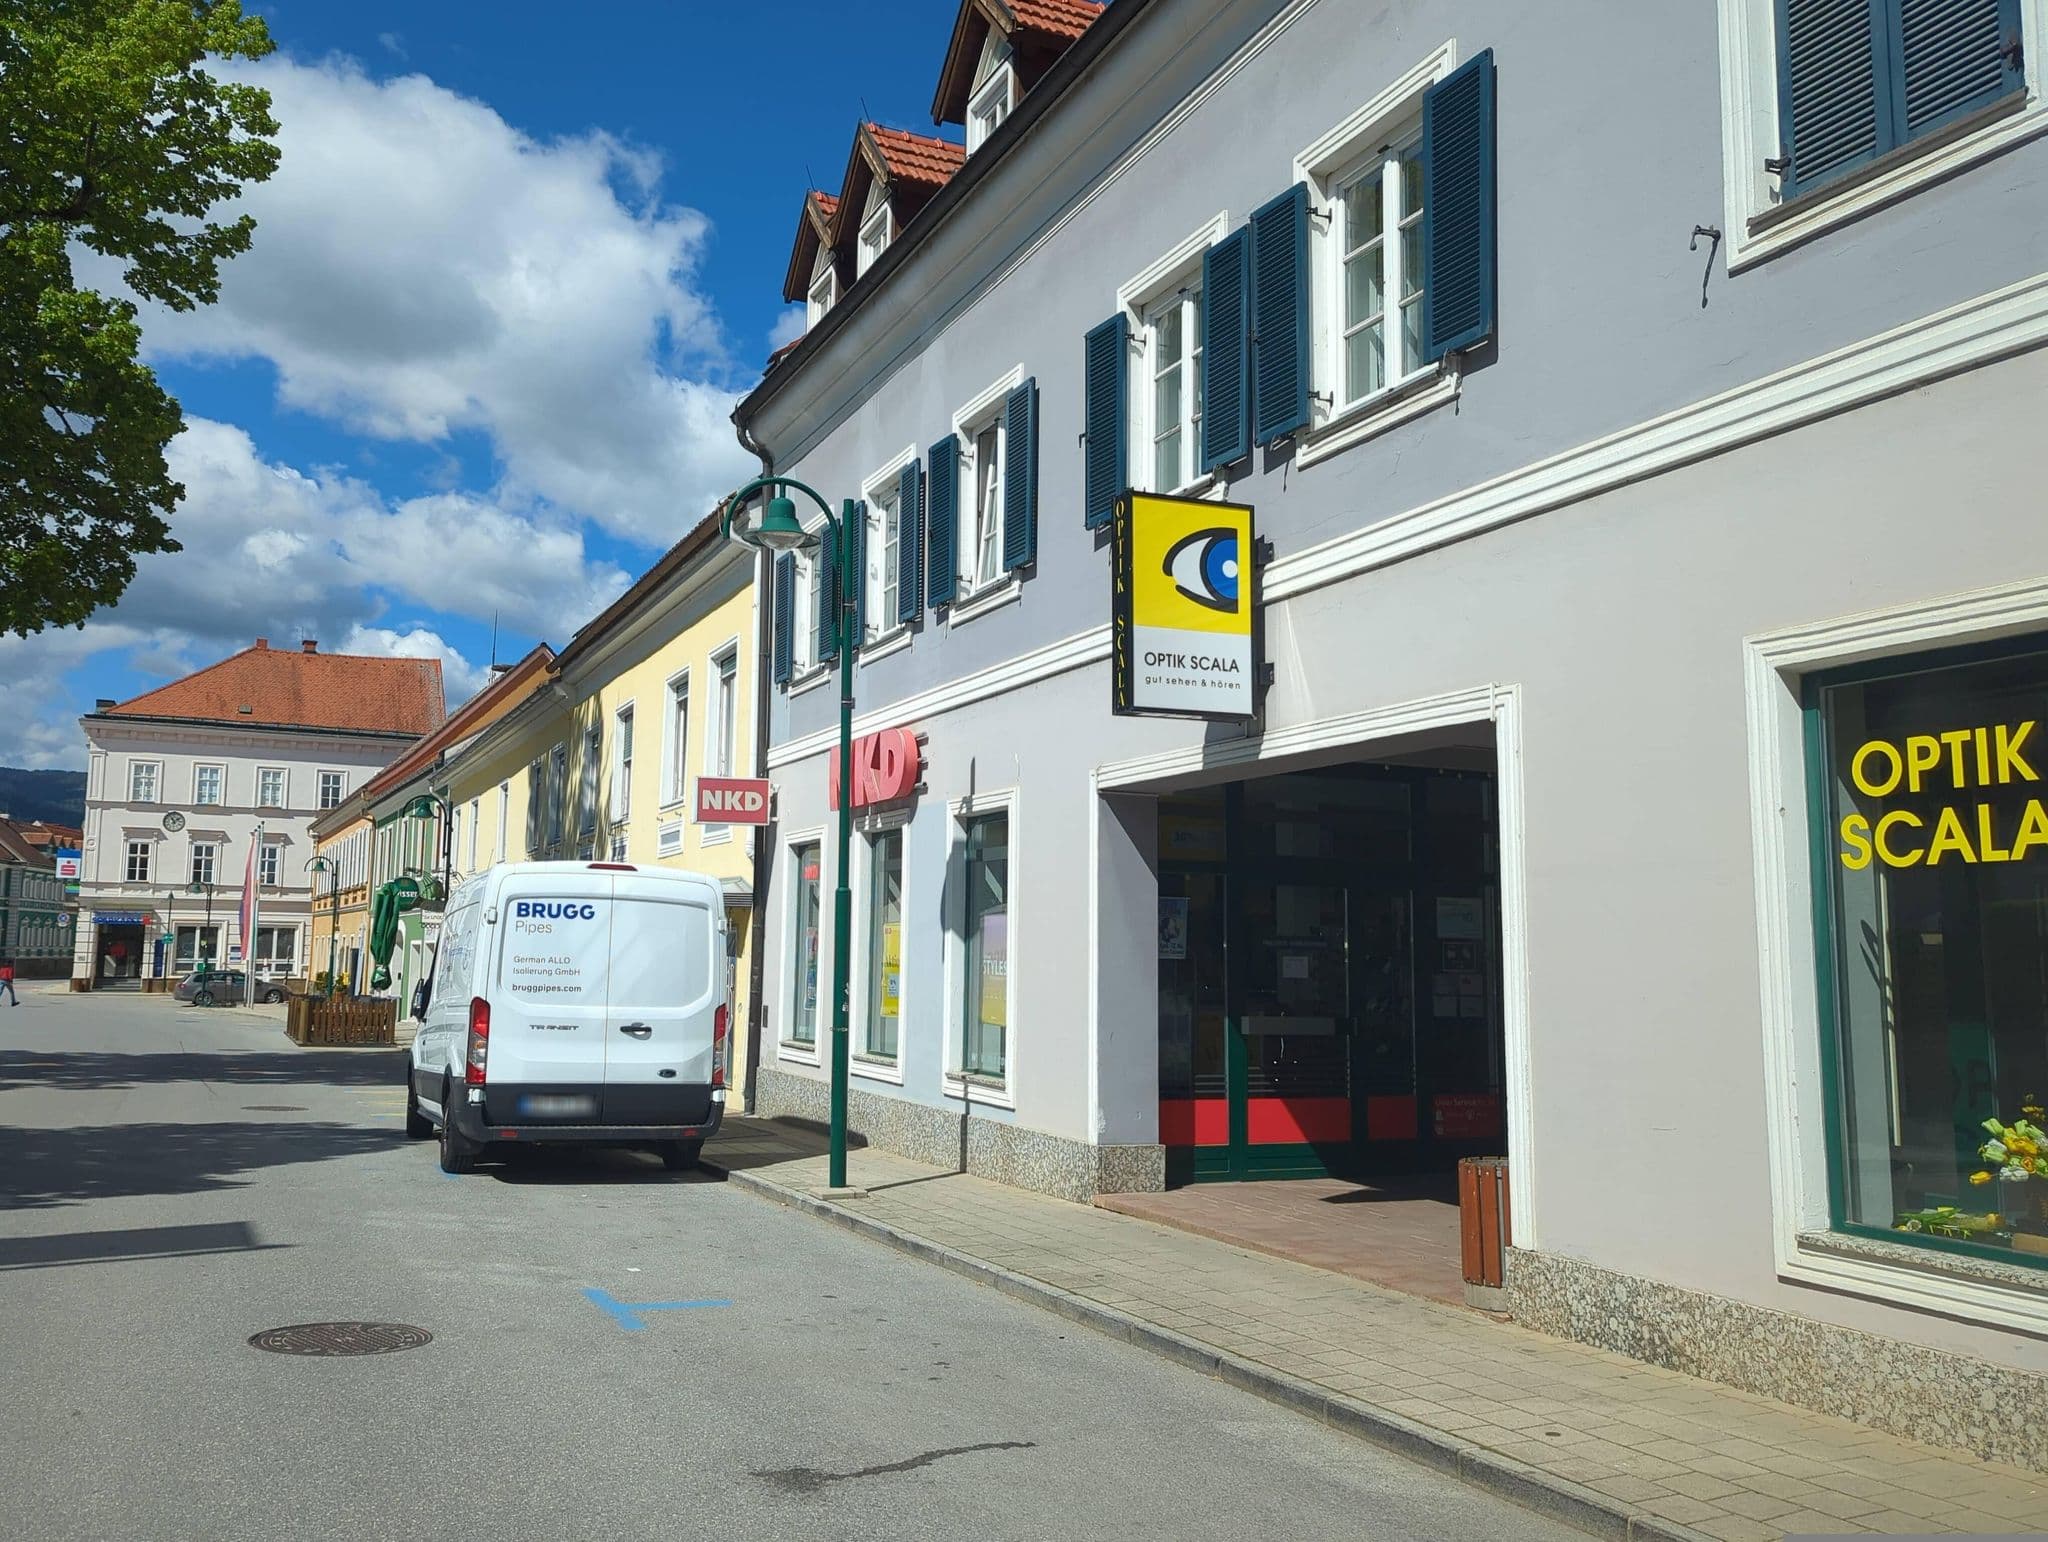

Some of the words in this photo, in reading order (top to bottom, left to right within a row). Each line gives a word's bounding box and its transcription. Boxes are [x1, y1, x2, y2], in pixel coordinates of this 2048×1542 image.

[1115, 500, 1125, 594] OPTIK
[1115, 614, 1125, 707] SCALA
[1144, 651, 1186, 669] OPTIK
[1191, 656, 1240, 673] SCALA
[1145, 675, 1162, 686] gut
[1166, 676, 1198, 687] sehen
[1201, 677, 1207, 687] &
[1210, 677, 1241, 690] hören
[1852, 720, 2040, 797] OPTIK
[702, 789, 763, 812] NKD
[1840, 800, 2048, 870] SCALA
[516, 902, 595, 920] BRUGG
[515, 920, 553, 935] Pipes
[513, 956, 546, 964] German
[548, 956, 571, 964] ALLO
[513, 967, 553, 976] Isolierung
[555, 968, 581, 976] GmbH
[512, 983, 582, 993] bruggpipes.com
